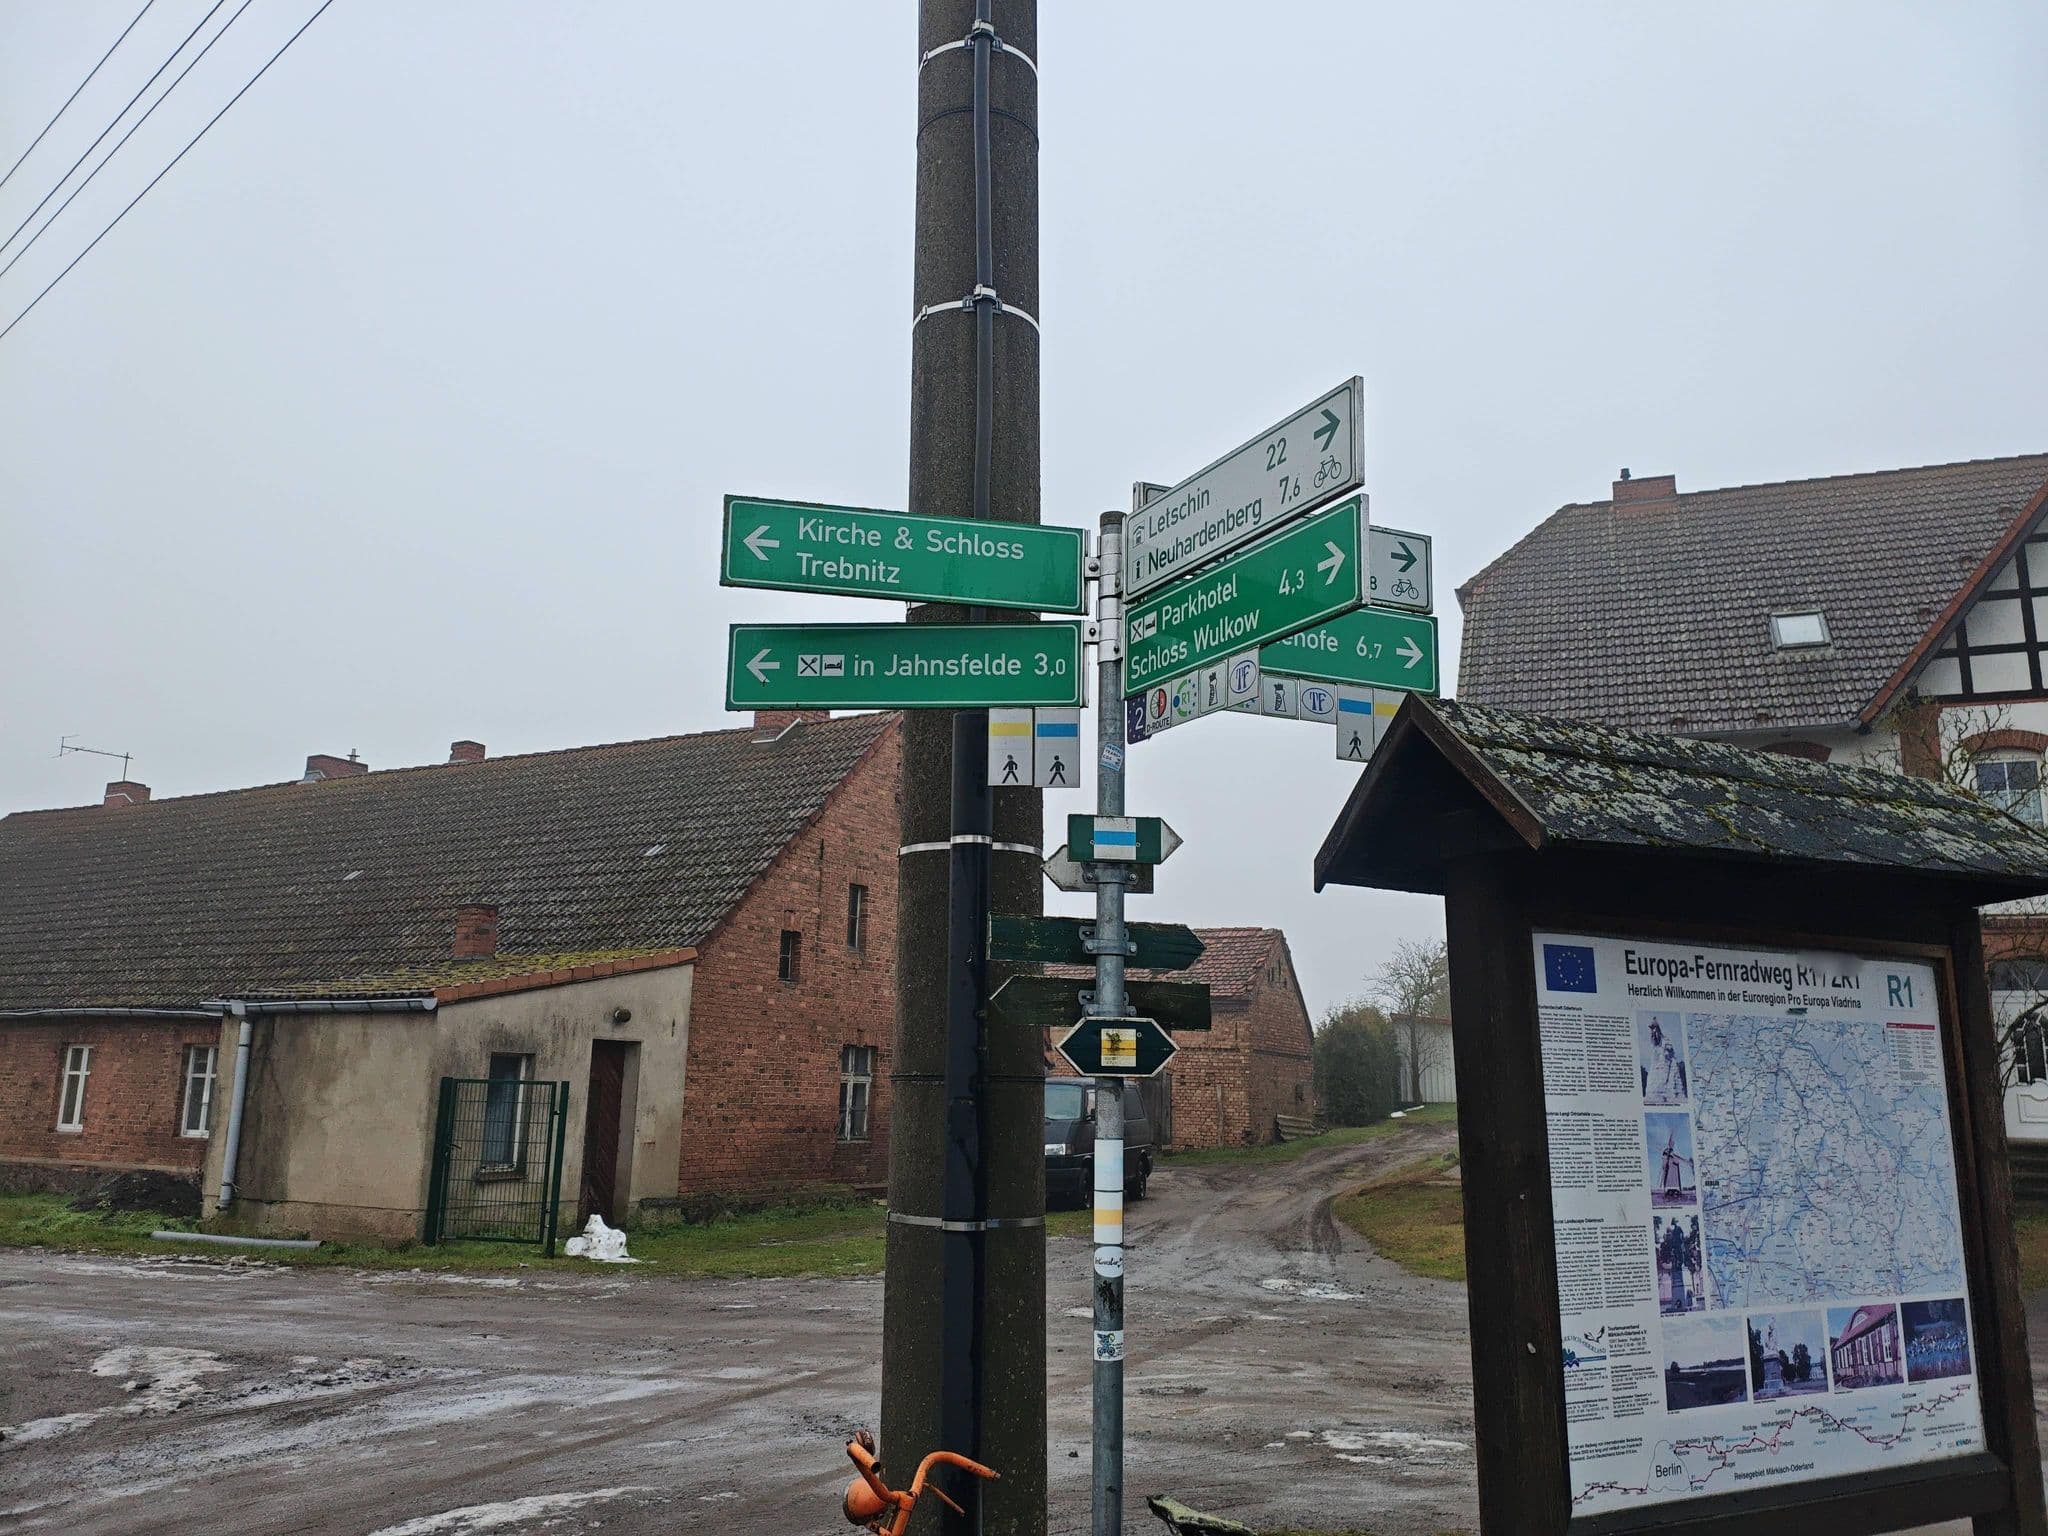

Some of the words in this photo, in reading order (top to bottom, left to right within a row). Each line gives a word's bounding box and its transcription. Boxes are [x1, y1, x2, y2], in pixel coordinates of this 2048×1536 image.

[1266, 437, 1287, 472] 22
[1279, 475, 1301, 505] 7,6
[1148, 487, 1210, 539] Letschin
[798, 517, 882, 547] Kirche
[894, 526, 914, 551] &
[926, 529, 1025, 561] Schloss
[1148, 497, 1262, 575] Neuhardenberg
[796, 552, 900, 584] Trebnitz
[1162, 573, 1238, 631] Parkhotel
[1278, 568, 1305, 596] 4,3
[1131, 640, 1188, 680] Schloss
[1193, 609, 1260, 653] Wulkow
[1355, 635, 1383, 660] 6,7
[853, 654, 875, 677] in
[883, 653, 1022, 677] Jahnsfelde
[1034, 652, 1067, 678] 3,0
[1135, 706, 1144, 731] 2
[1146, 716, 1171, 733] D-ROUTE
[1624, 950, 1793, 992] Europa-Fernradweg
[1627, 983, 1663, 998] Herzlich
[1664, 985, 1716, 1001] Willkommen
[1717, 988, 1726, 1001] in
[1727, 989, 1741, 1002] der
[1742, 990, 1786, 1007] Euroregion
[1787, 993, 1801, 1006] Pro
[1802, 994, 1830, 1009] Europa
[1830, 996, 1862, 1009] Viadrina
[1886, 974, 1914, 1008] R1
[1655, 1462, 1683, 1479] Berlin
[1733, 1469, 1766, 1481] Reisegebiet
[1766, 1462, 1815, 1475] Märkisch-Oderland
